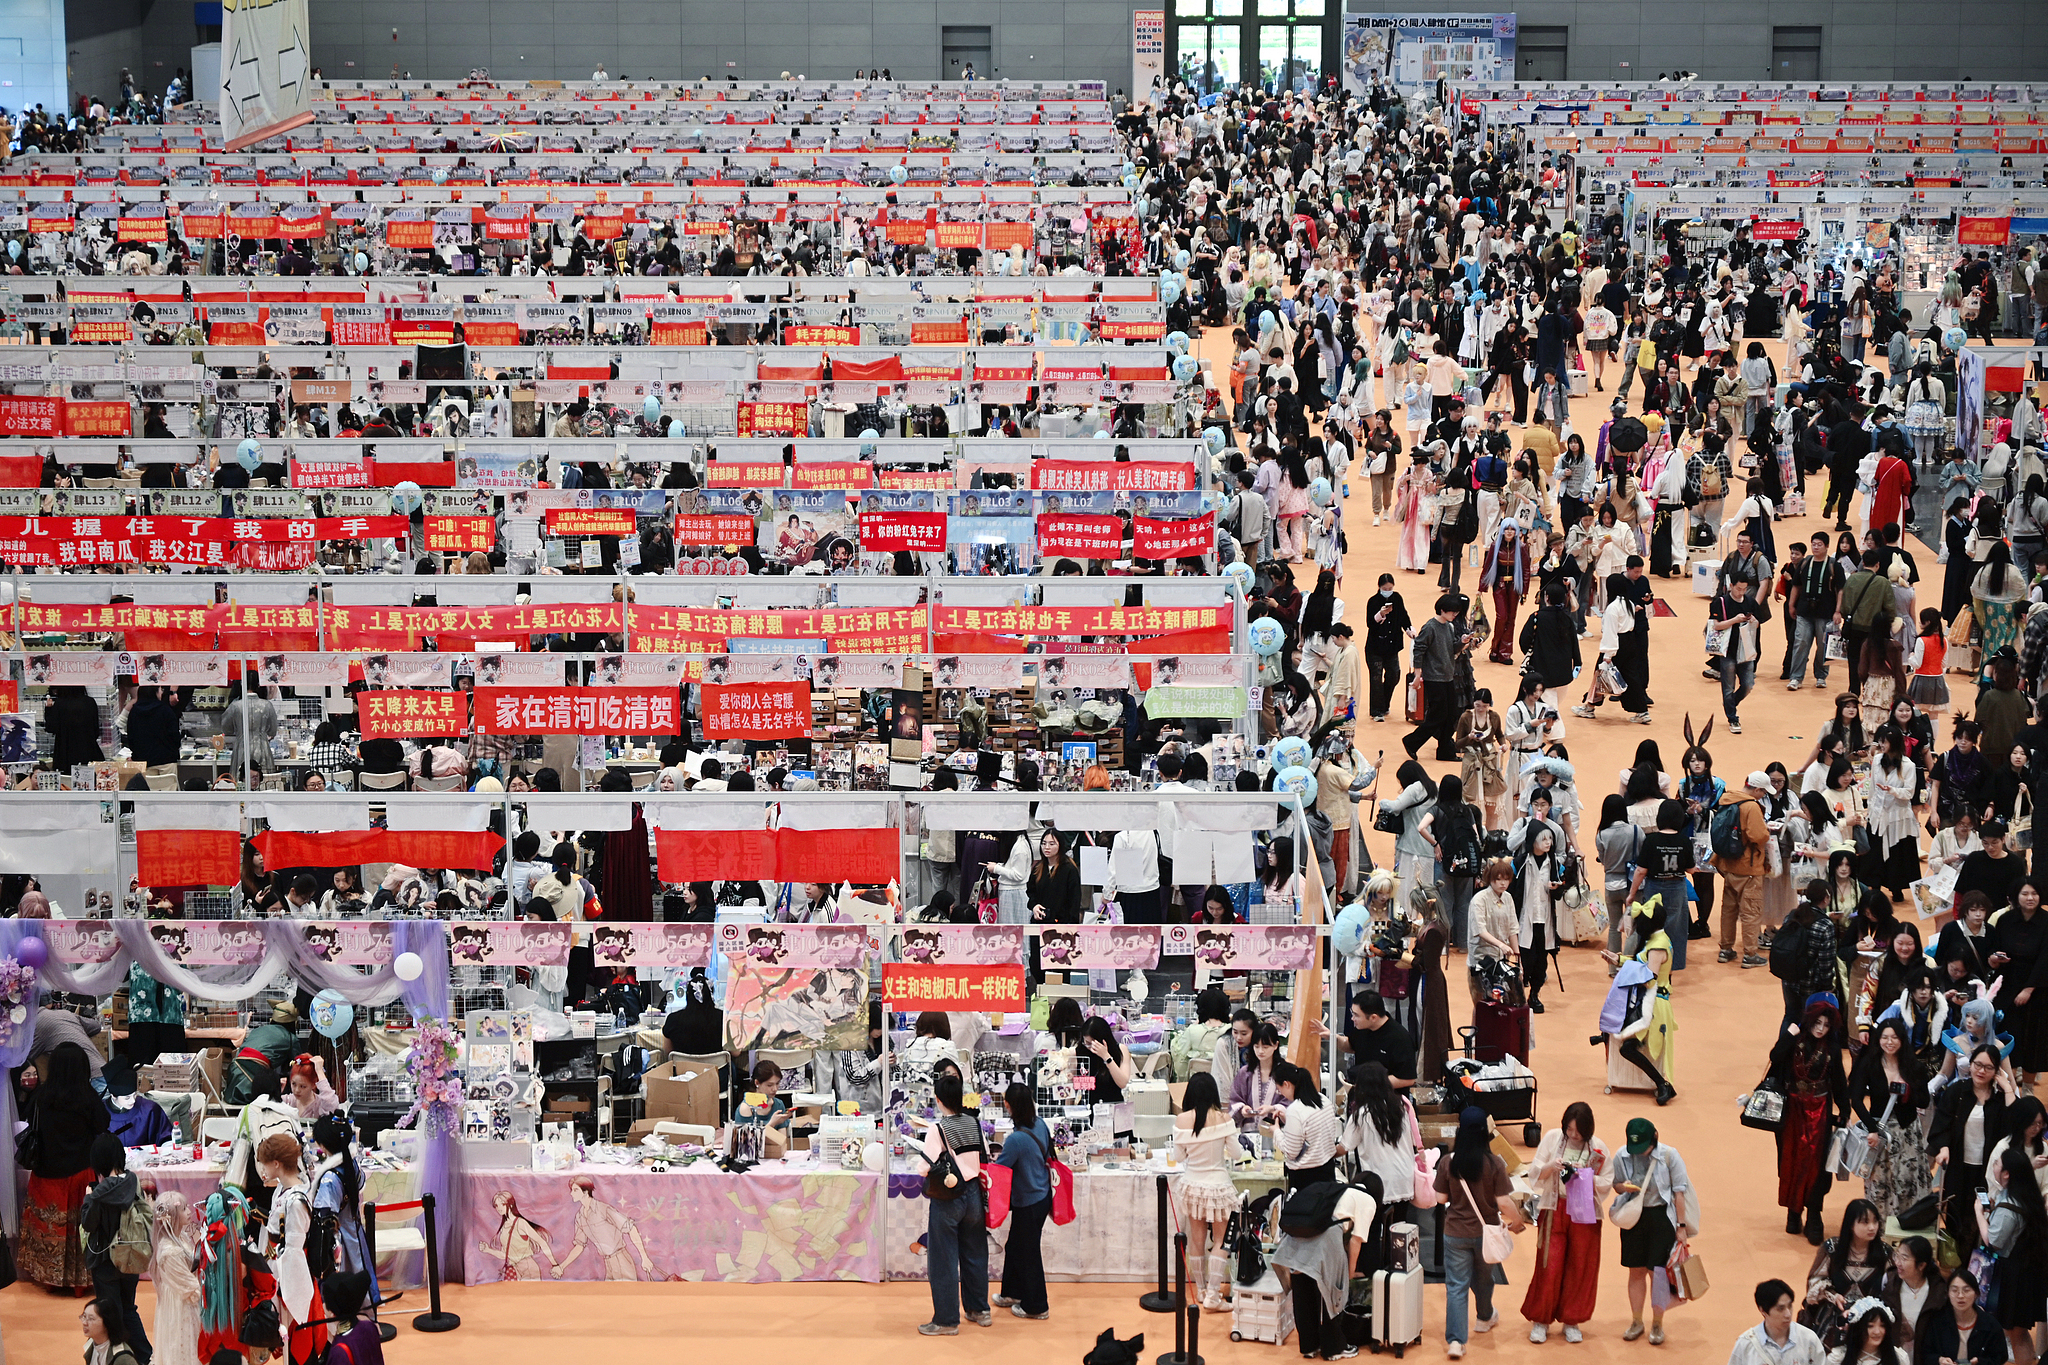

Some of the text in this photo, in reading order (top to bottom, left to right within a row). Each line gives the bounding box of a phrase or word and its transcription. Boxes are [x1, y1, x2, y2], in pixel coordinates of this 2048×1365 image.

[30, 308, 54, 316] 肆N18
[89, 308, 113, 316] 肆N17
[222, 308, 246, 316] 肆N15
[284, 308, 308, 316] 肆N14
[348, 308, 372, 316] 肆N13
[417, 308, 440, 316] 肆N12
[478, 308, 502, 316] 肆N11
[541, 308, 565, 316] 肆N10
[608, 308, 633, 316] 肆N09
[668, 308, 692, 316] 肆N08
[733, 308, 757, 316] 肆N07
[305, 385, 337, 395] 肆M12
[67, 406, 127, 419] 养父对养子
[755, 404, 793, 415] 质问老人
[5, 417, 52, 430] 心法文案
[755, 416, 793, 428] 狗还养吗
[74, 496, 105, 507] 肆L13
[171, 496, 202, 507] 肆L12
[253, 496, 284, 507] 肆L11
[342, 496, 373, 507] 肆L10
[442, 496, 473, 507] 肆L09
[613, 496, 643, 507] 肆L07
[711, 496, 742, 507] 肆L06
[793, 496, 825, 507] 肆L05
[882, 496, 912, 507] 肆L04
[981, 496, 1012, 507] 肆L03
[1062, 496, 1093, 507] 肆L02
[1150, 496, 1179, 507] 肆L01
[1144, 536, 1207, 550] 心地还那么善良
[59, 539, 134, 563] 我母南瓜
[149, 538, 224, 565] 我父江晏
[369, 695, 455, 716] 天降来太早
[719, 692, 794, 709] 爱你的人会弯腰
[496, 695, 674, 730] 家在清河吃清贺
[370, 718, 457, 733] 不小心变成竹马了
[709, 711, 805, 731] 卧槽怎么是无名学长
[1662, 855, 1678, 871] 14
[884, 975, 1020, 1000] 义主和泡椒凤爪一样好吃
